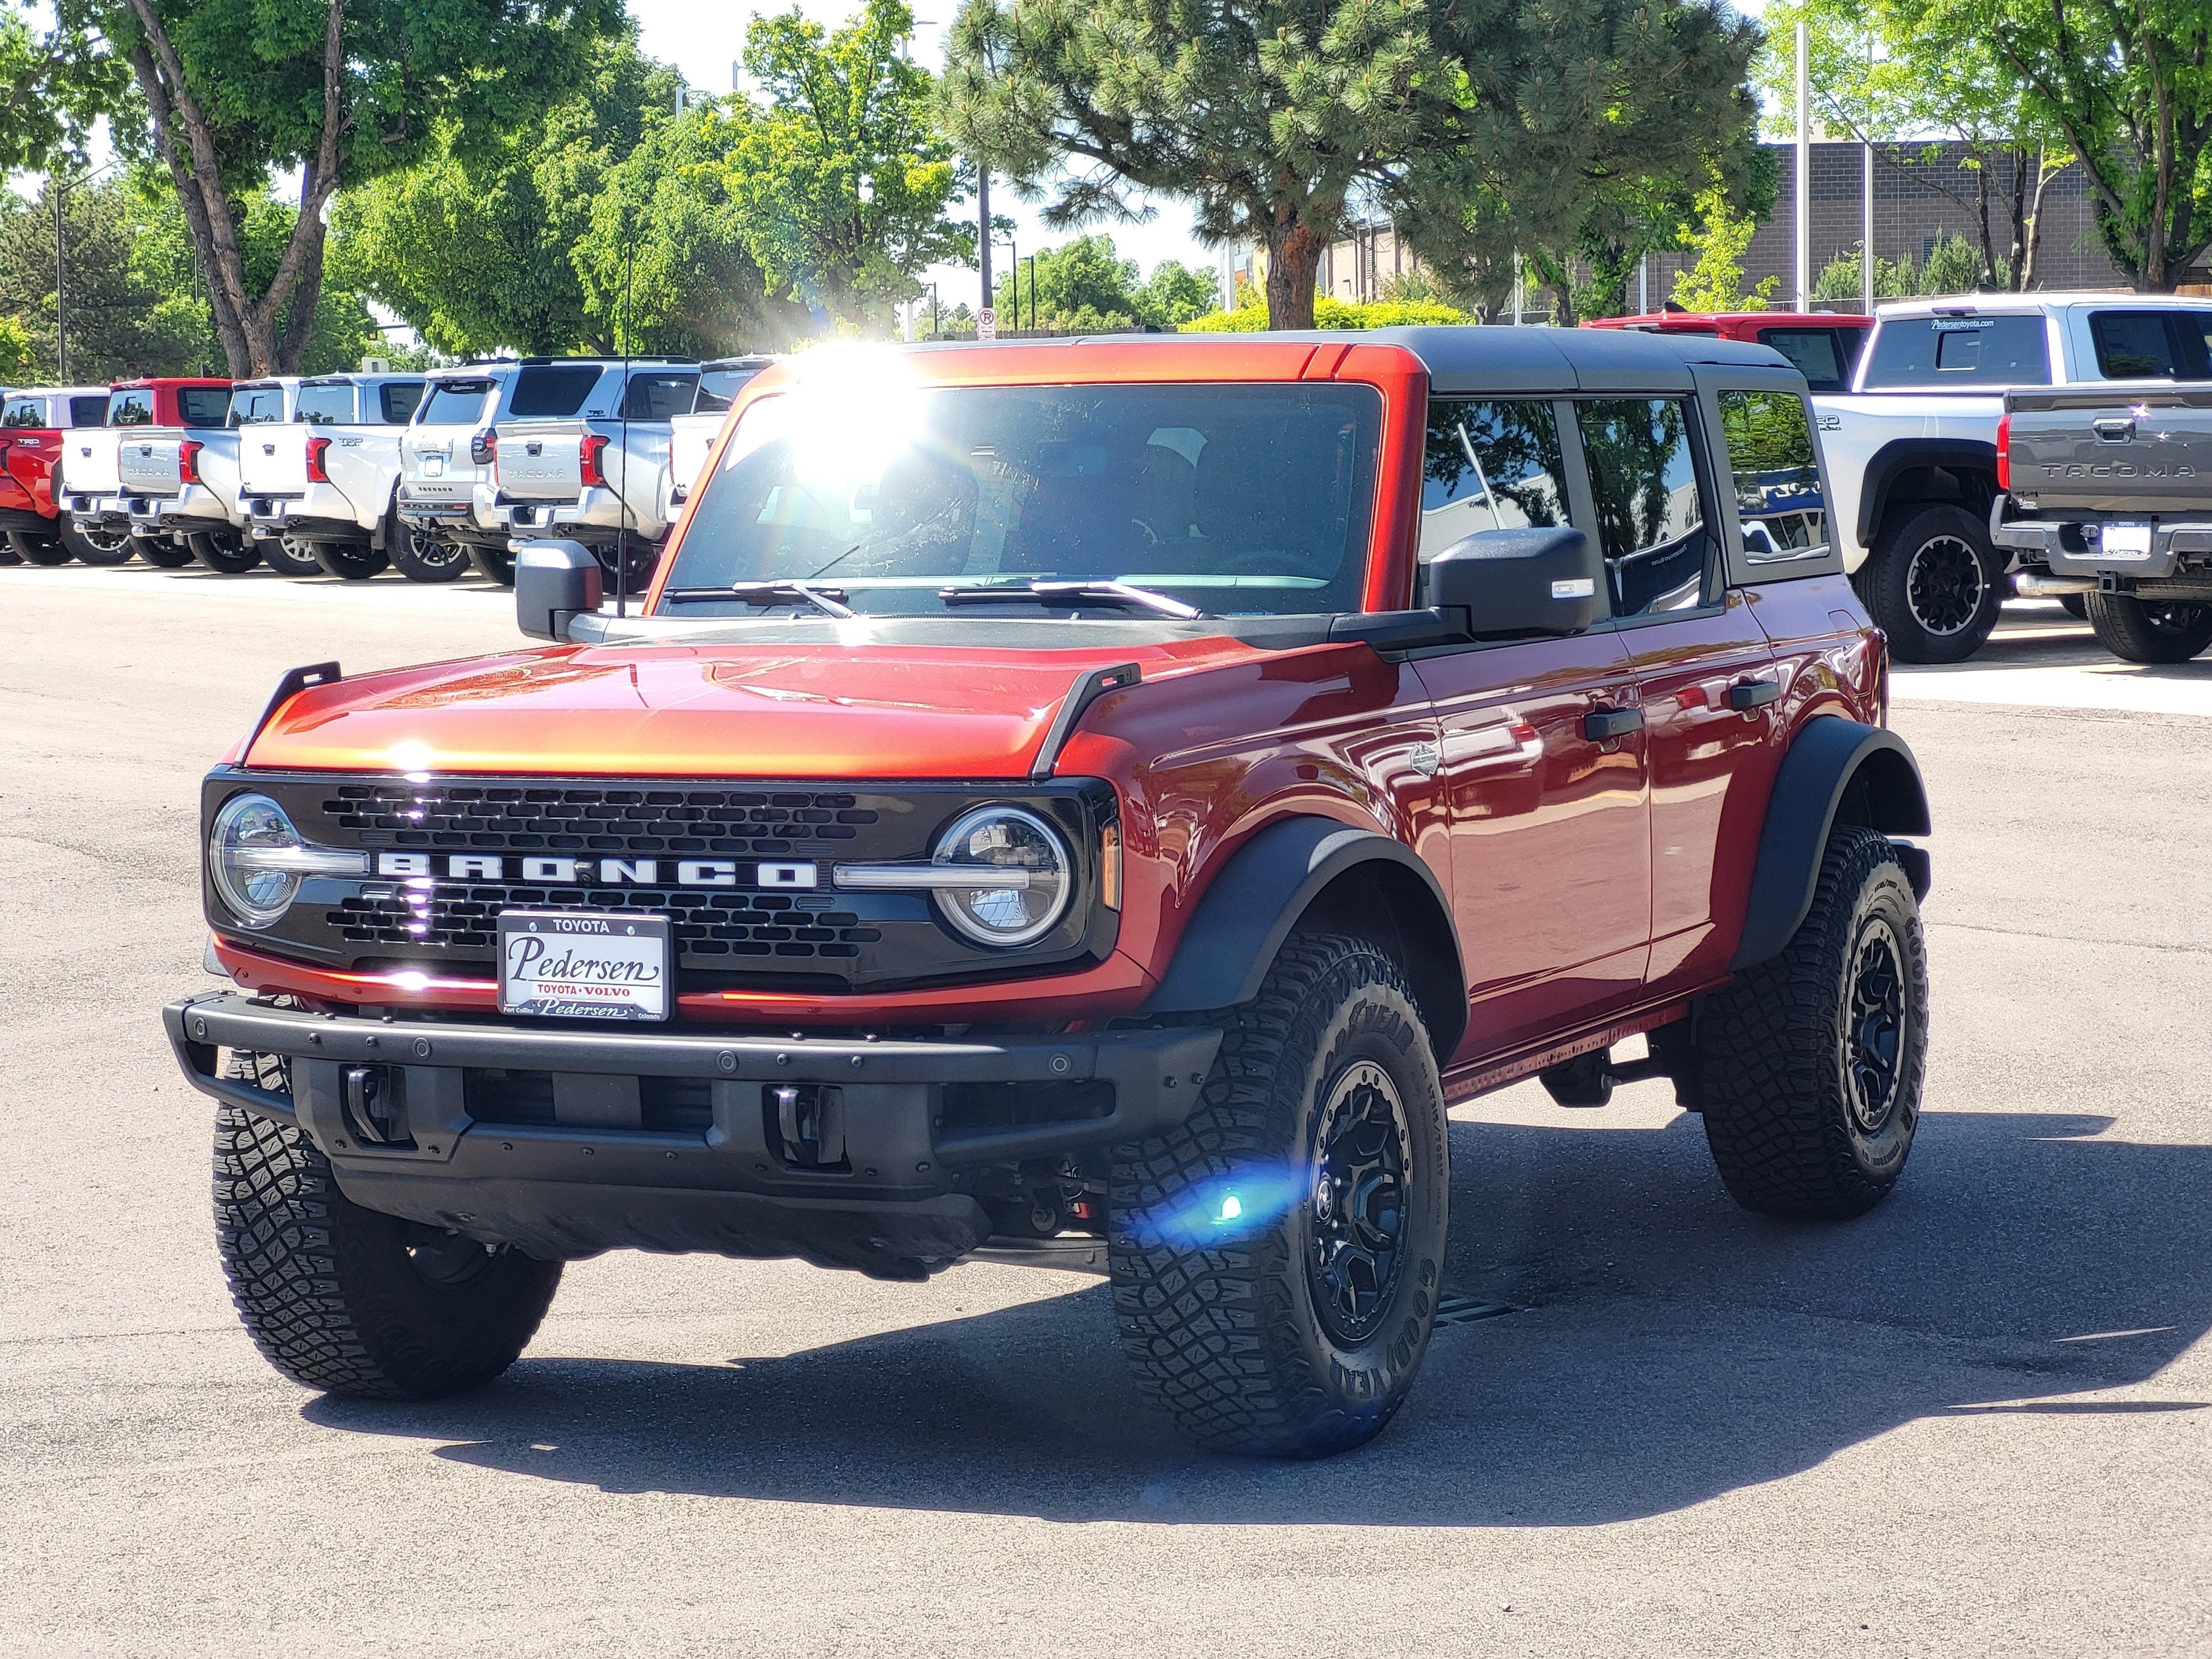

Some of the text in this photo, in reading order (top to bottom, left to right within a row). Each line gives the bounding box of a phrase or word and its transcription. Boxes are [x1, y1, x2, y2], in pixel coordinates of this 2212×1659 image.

[1931, 319, 1995, 330] Pedersentoyota.com
[508, 469, 566, 478] TACOMA
[2040, 465, 2195, 477] TACOMA
[378, 852, 817, 888] BRONCO
[552, 919, 610, 933] TOYOTA
[509, 936, 660, 981] Pedersen
[538, 984, 630, 997] TOYOTA VOLVO
[537, 996, 628, 1016] Pedersen
